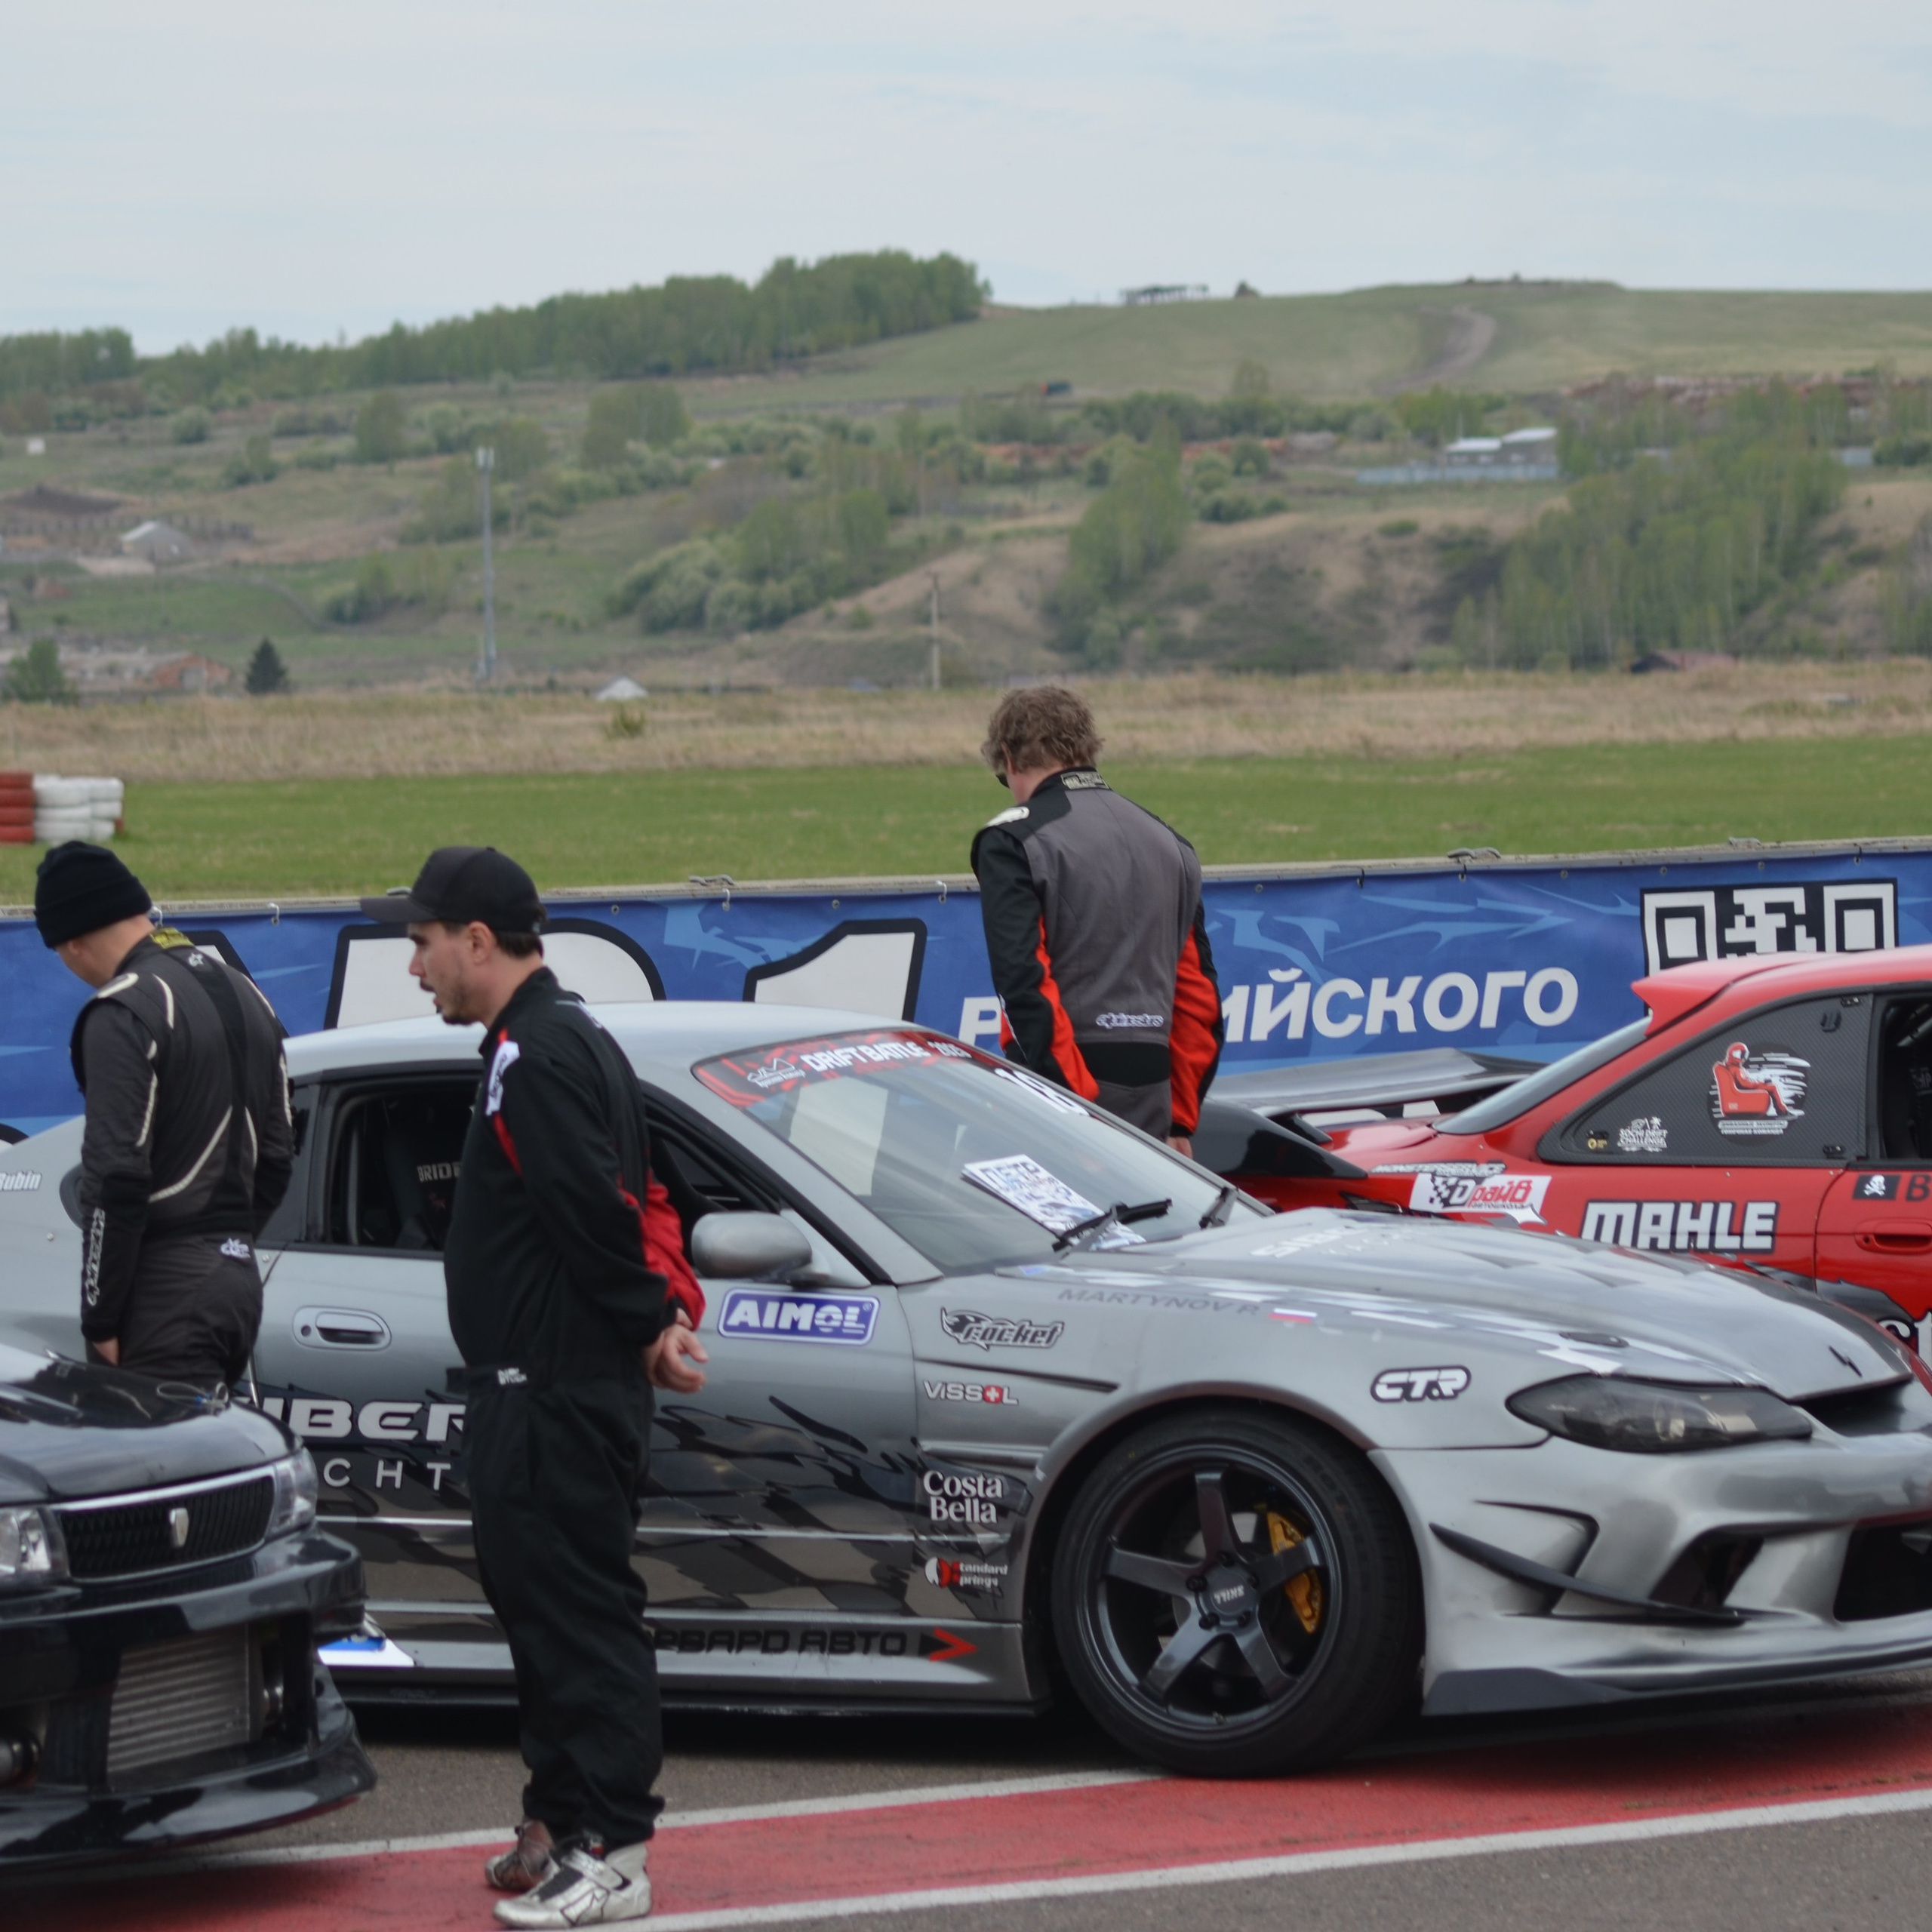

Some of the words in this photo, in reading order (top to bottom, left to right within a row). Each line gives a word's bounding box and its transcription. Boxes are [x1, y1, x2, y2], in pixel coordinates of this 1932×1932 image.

[800, 1050, 868, 1072] DRIFT
[860, 1041, 932, 1063] BATTLE
[1581, 1201, 1777, 1250] MAHLE
[1057, 1288, 1232, 1312] MARTYNOV
[924, 1470, 1003, 1498] Costa
[931, 1496, 998, 1524] Bella
[798, 1630, 907, 1656] АВТО
